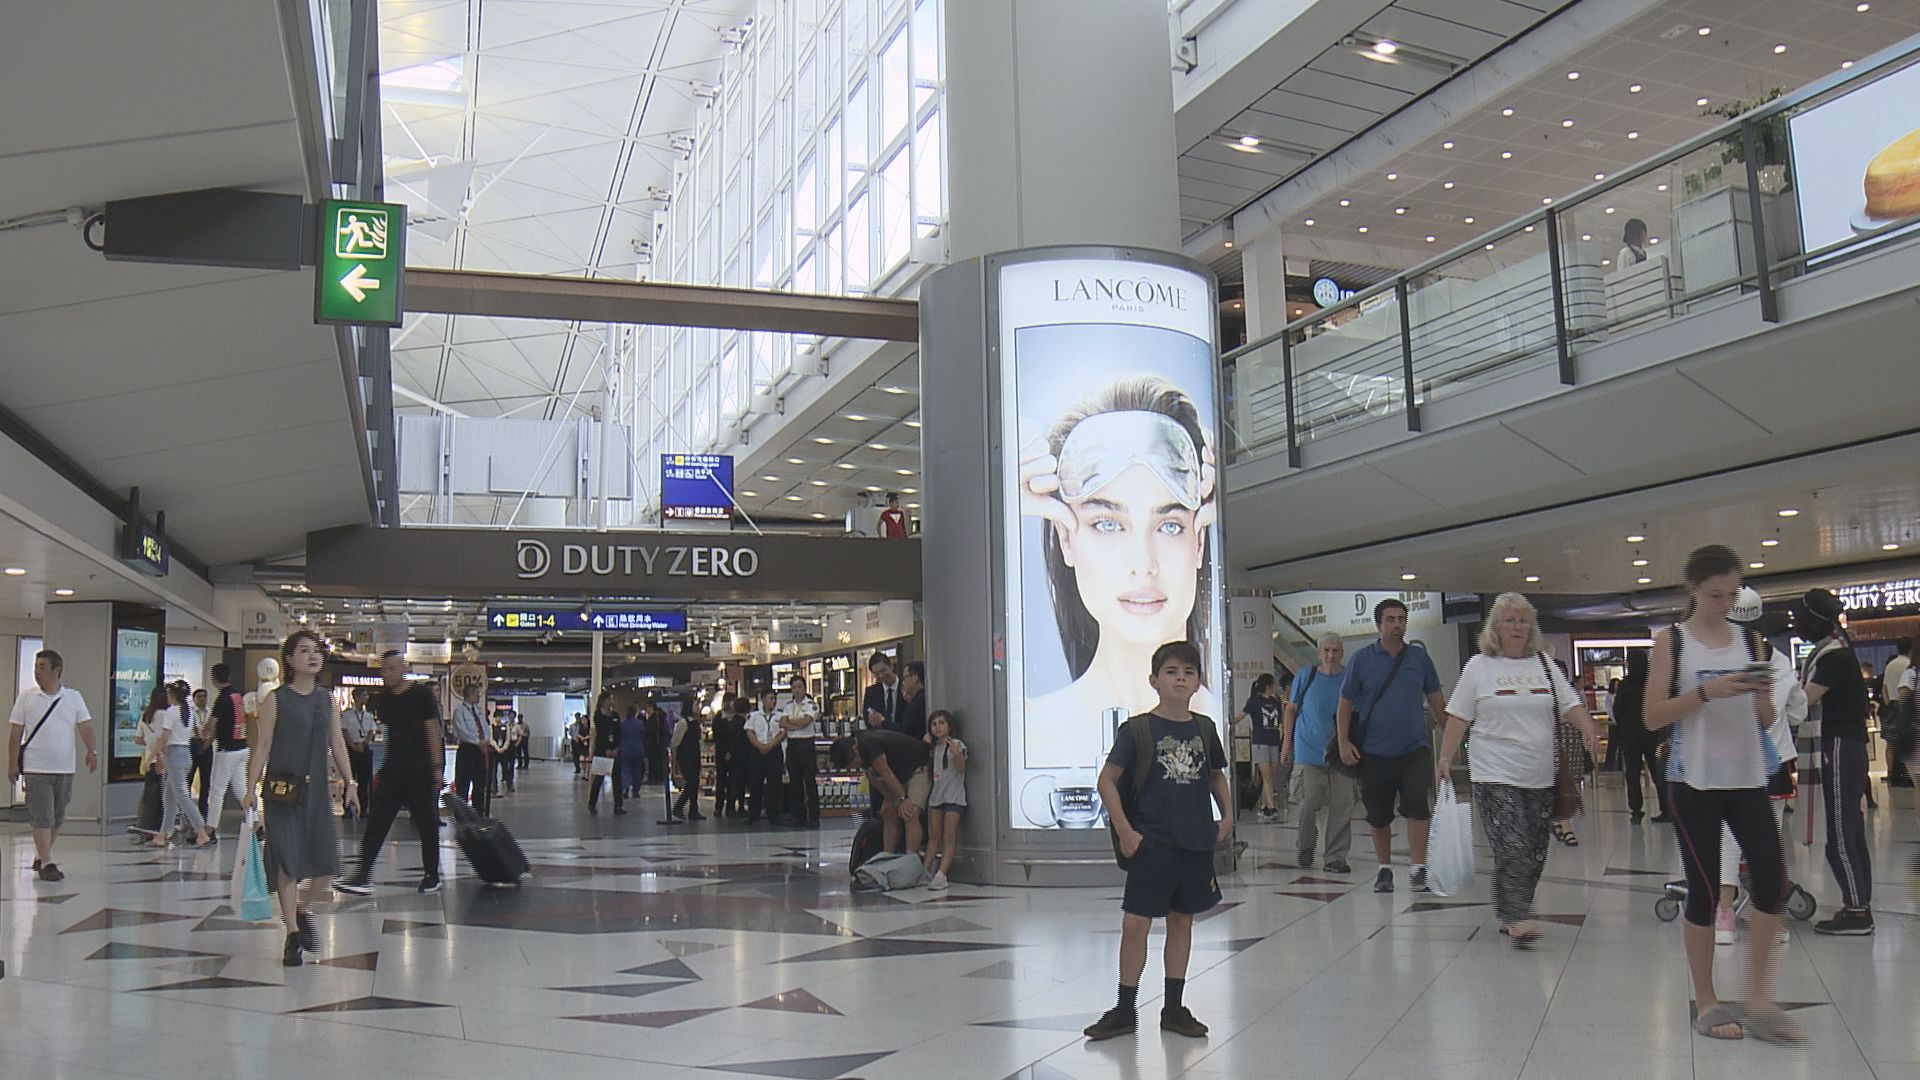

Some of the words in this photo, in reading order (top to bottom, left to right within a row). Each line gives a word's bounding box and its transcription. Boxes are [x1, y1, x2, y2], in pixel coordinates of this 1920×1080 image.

[1052, 276, 1187, 311] LANCÔME
[1112, 304, 1144, 312] PARIS
[562, 544, 660, 576] DUTY
[665, 546, 759, 577] ZERO
[1839, 592, 1880, 611] DUTY
[537, 614, 556, 628] 1-4
[629, 622, 652, 630] Drinking
[125, 638, 150, 649] VICHY
